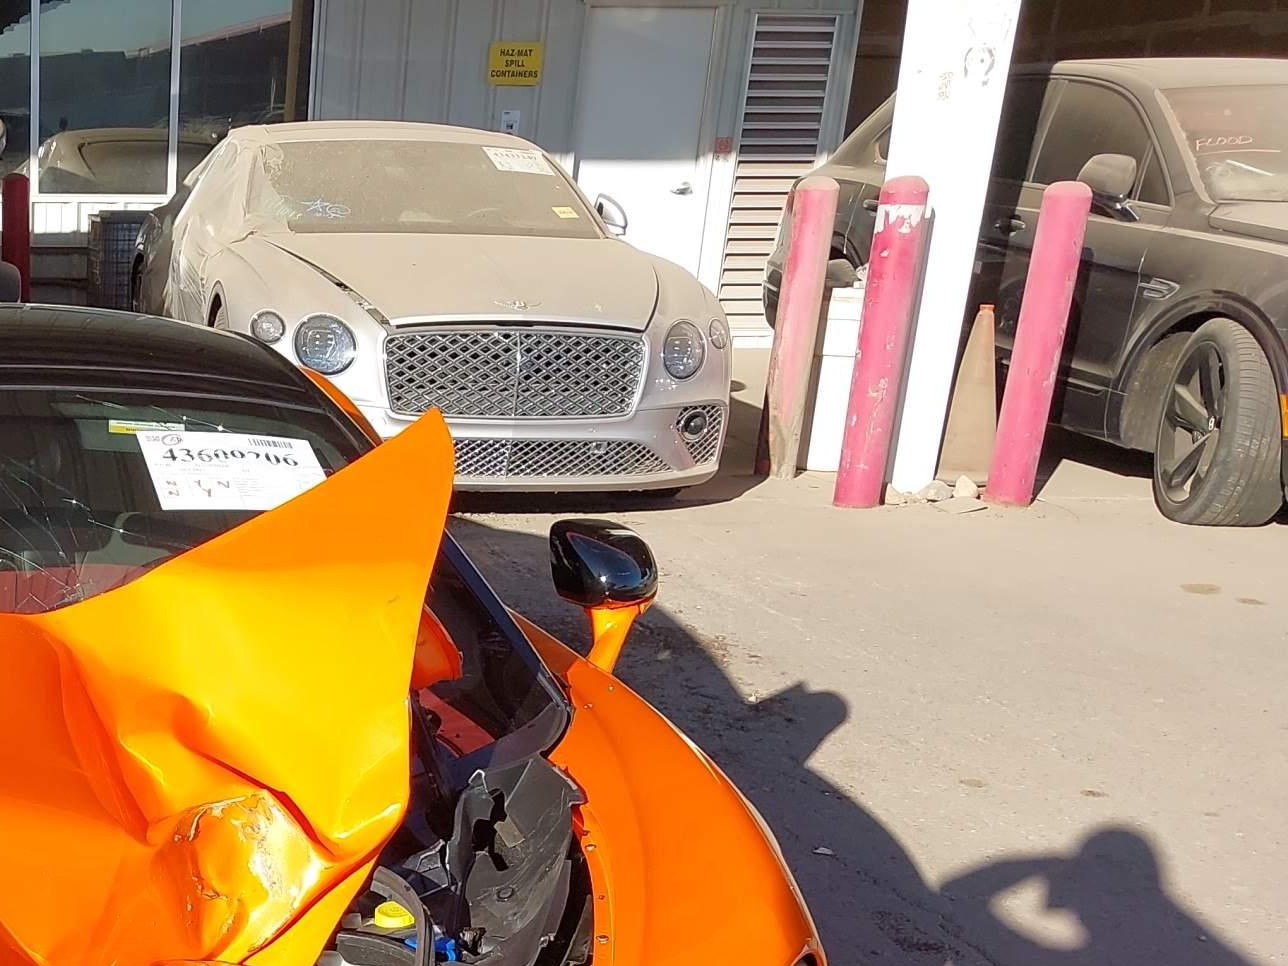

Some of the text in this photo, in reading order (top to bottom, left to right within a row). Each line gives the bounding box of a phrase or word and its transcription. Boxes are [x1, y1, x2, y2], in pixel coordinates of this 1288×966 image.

[499, 48, 533, 57] HAZ-MAT
[504, 59, 525, 68] SPILL
[490, 69, 538, 79] CONTAINERS
[1195, 135, 1254, 152] FLOOD
